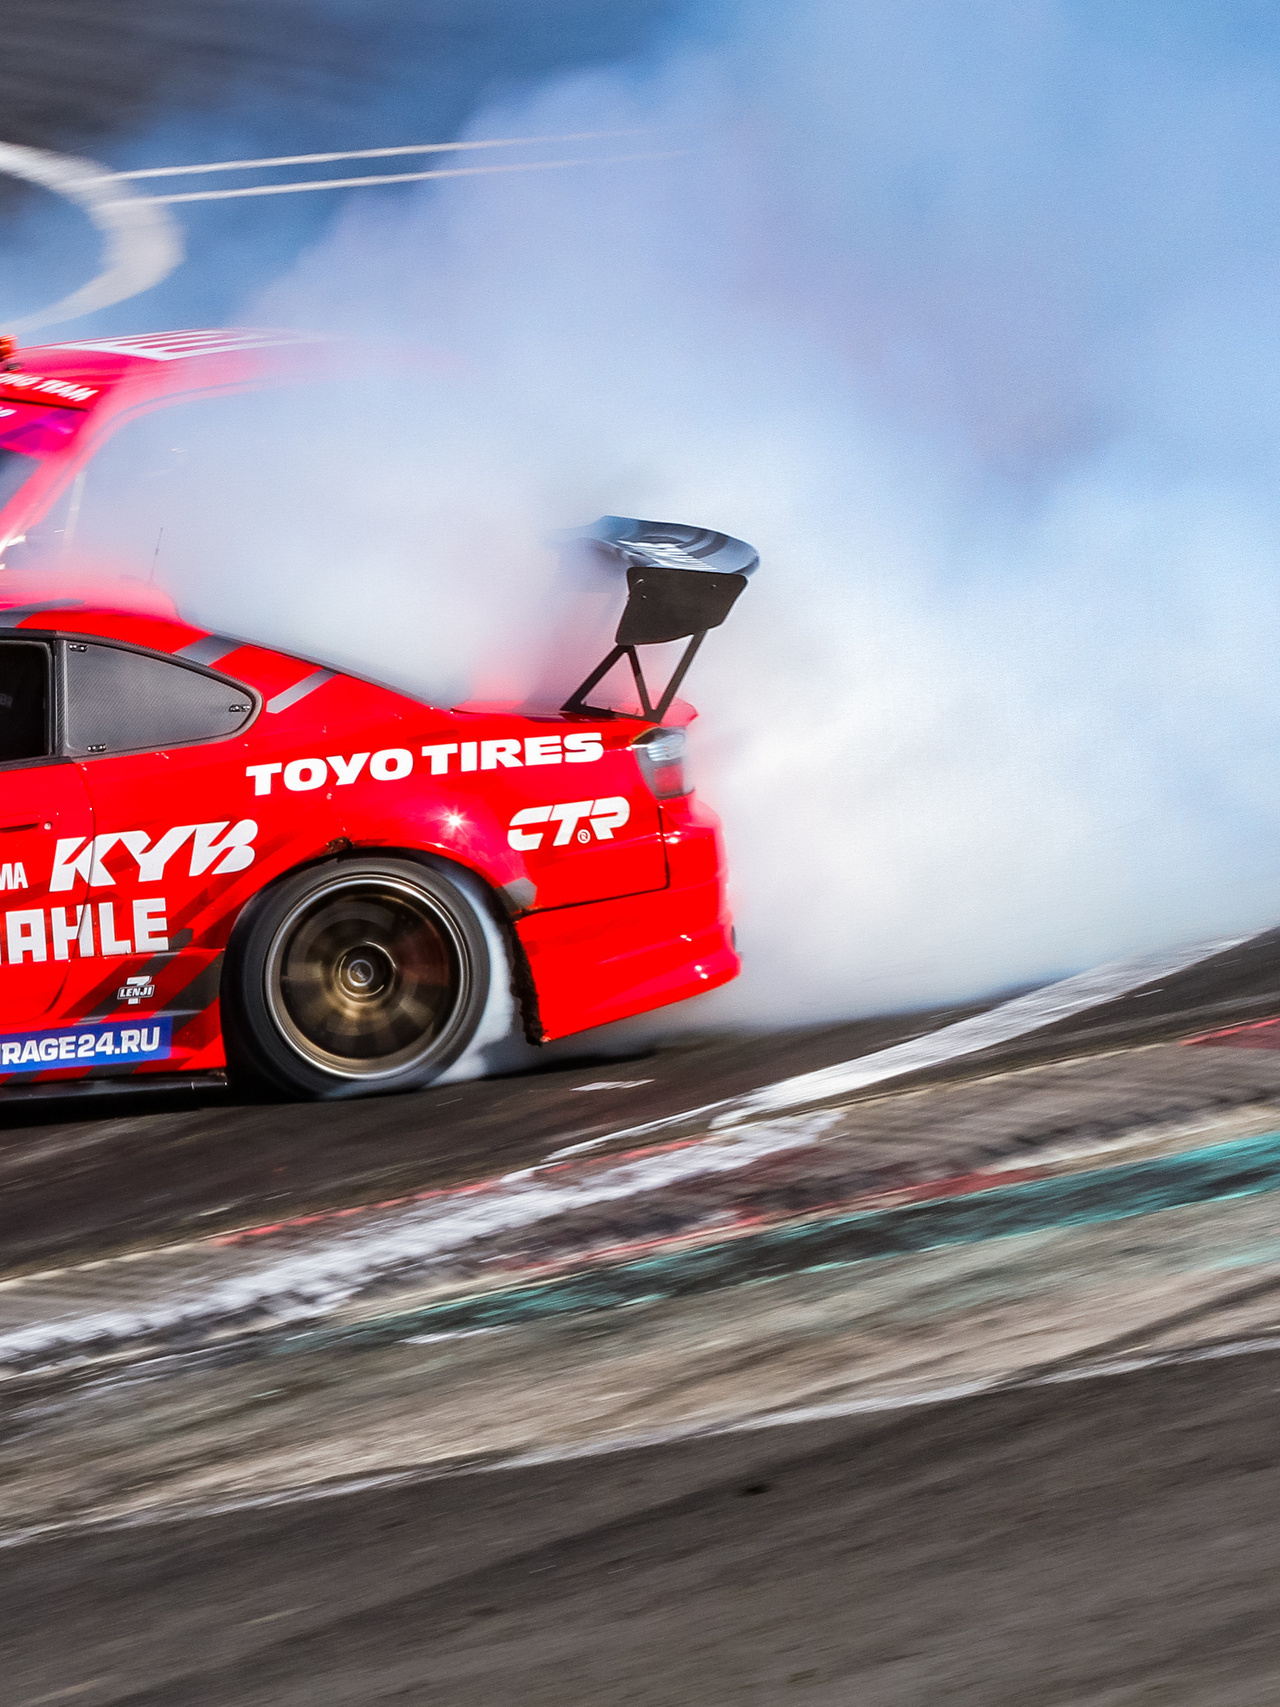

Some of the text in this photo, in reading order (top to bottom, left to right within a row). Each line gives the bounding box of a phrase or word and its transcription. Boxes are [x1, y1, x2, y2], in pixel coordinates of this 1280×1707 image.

[32, 379, 99, 402] TEAM
[246, 732, 603, 797] TOYO TIRES
[507, 796, 630, 852] CTR
[49, 819, 259, 893] KYB
[119, 986, 153, 998] LENJI
